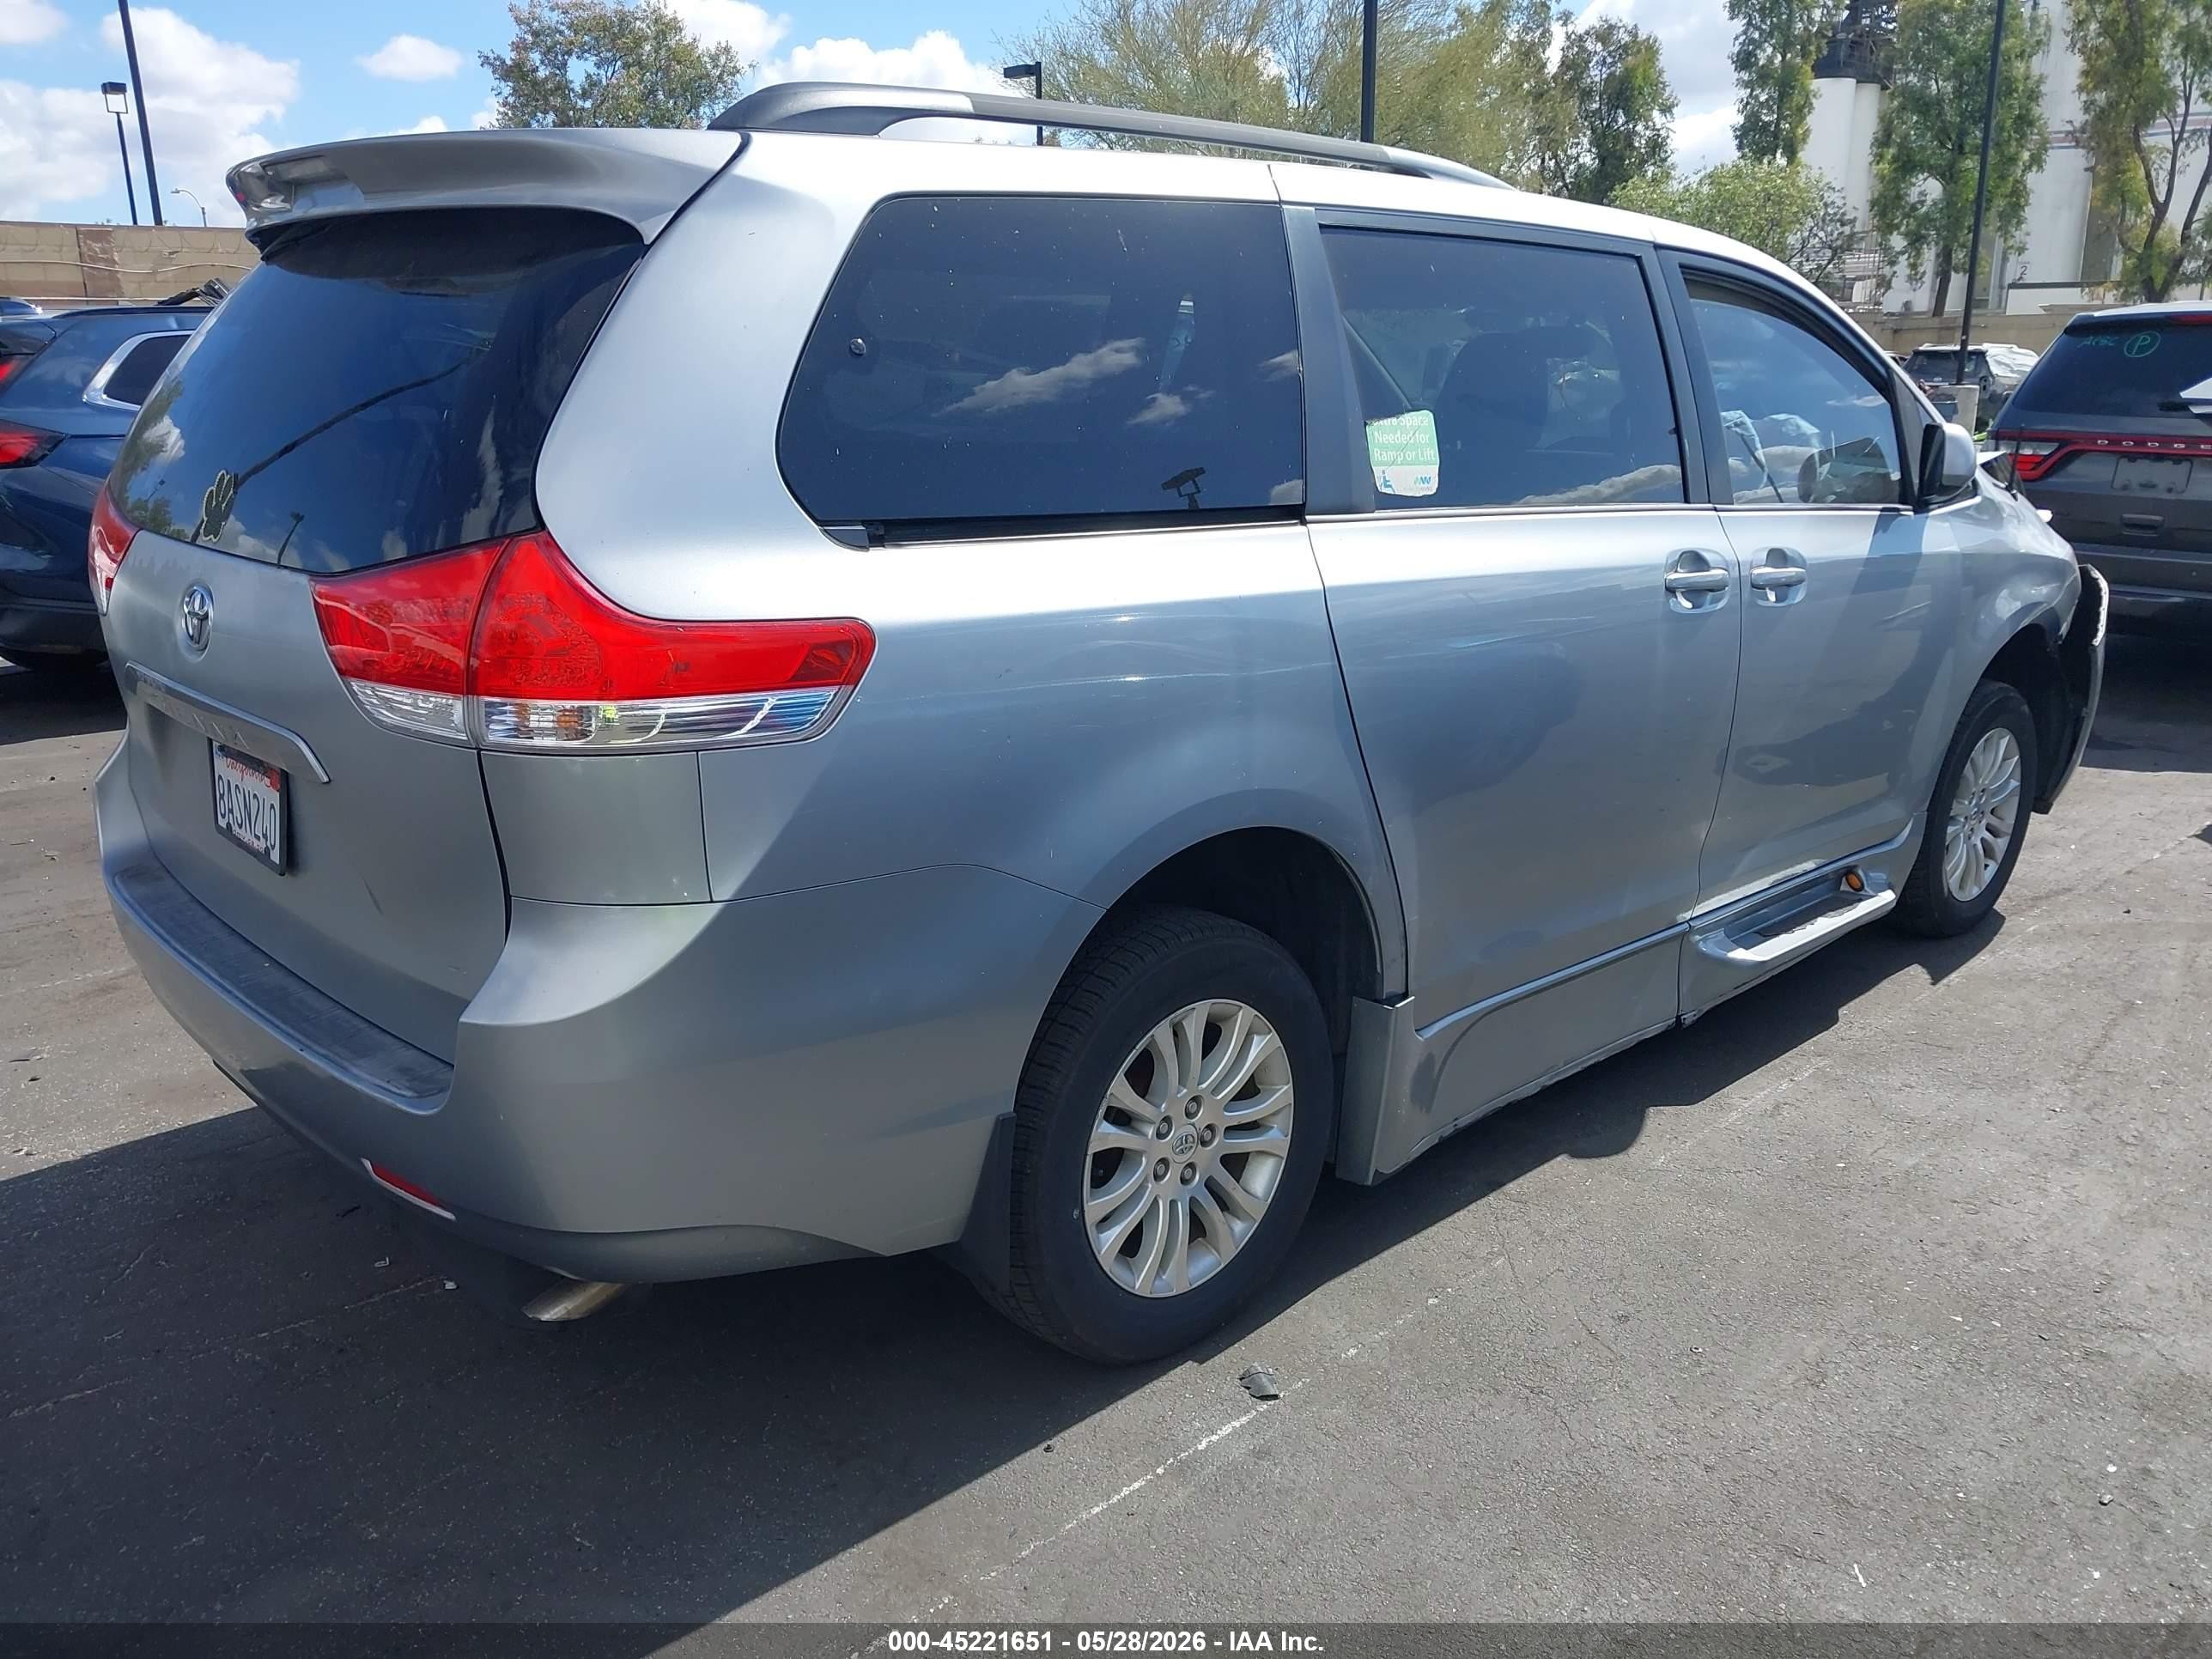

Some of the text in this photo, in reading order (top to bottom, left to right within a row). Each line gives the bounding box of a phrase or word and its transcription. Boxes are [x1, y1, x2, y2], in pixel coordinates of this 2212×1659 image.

[1401, 415, 1429, 428] Space
[1375, 430, 1431, 445] Needed for
[2097, 439, 2212, 450] DODGE
[1375, 447, 1437, 464] Ramp or Lift
[217, 774, 277, 851] 8ASN240
